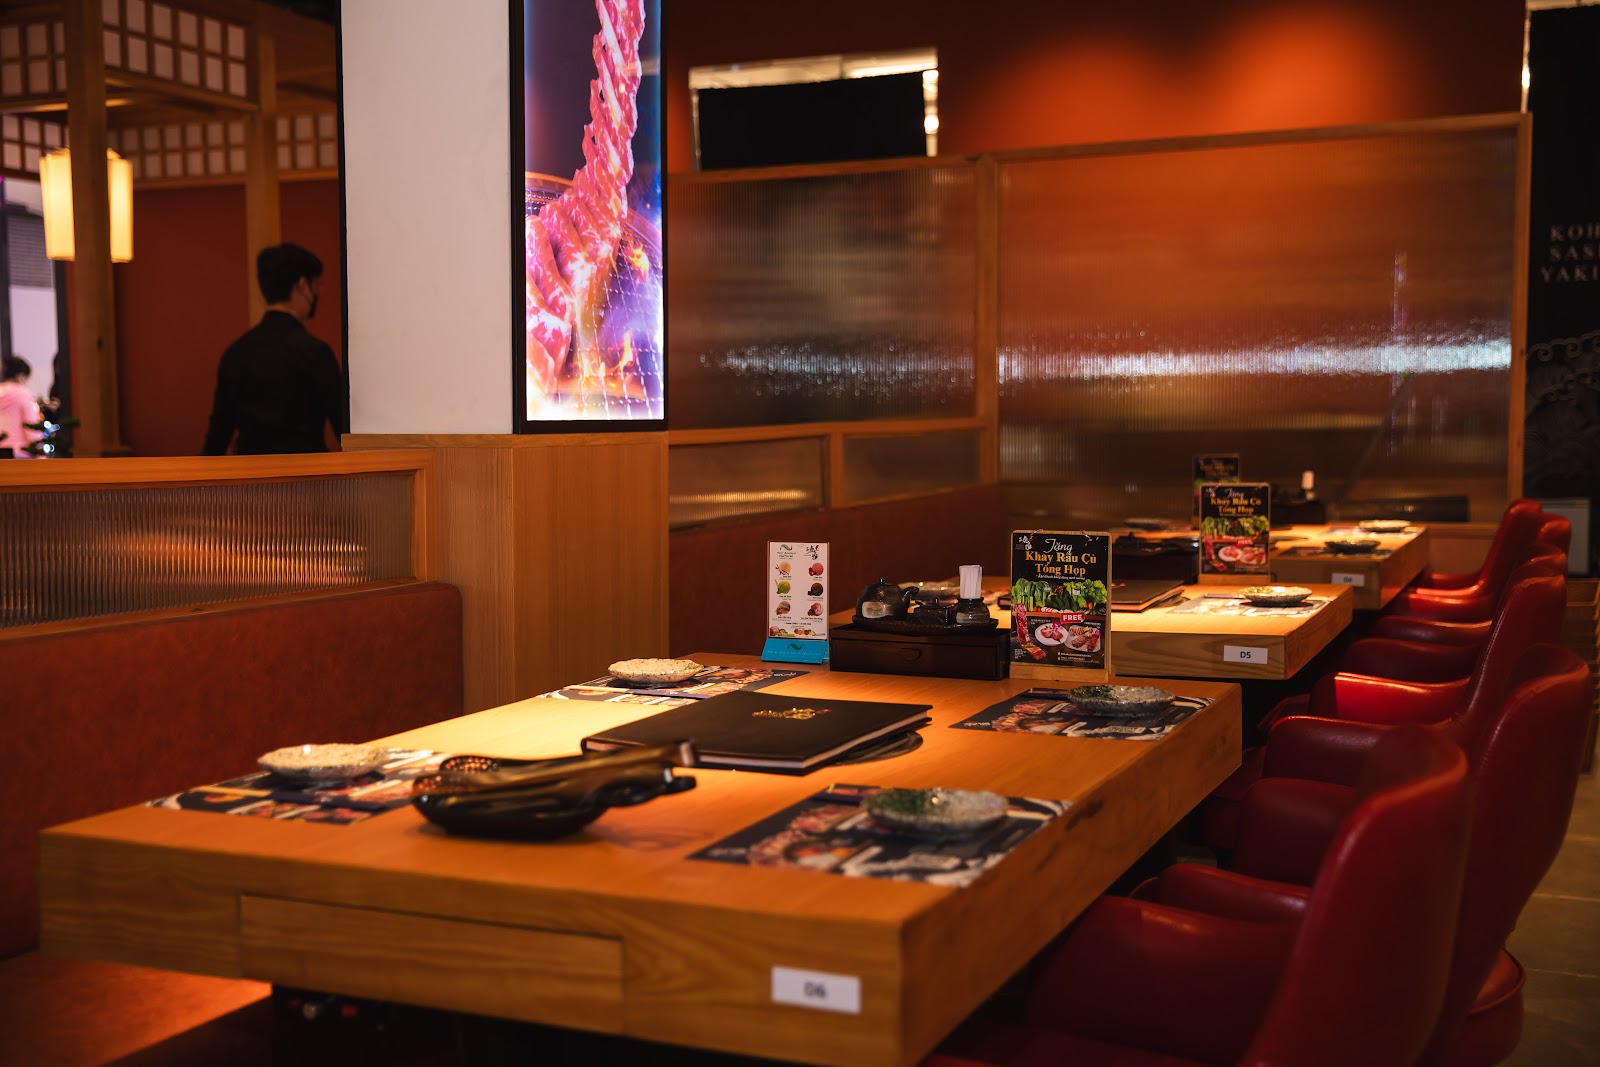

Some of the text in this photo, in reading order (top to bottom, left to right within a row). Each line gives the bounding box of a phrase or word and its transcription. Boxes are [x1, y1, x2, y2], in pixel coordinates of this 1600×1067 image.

[1550, 243, 1600, 261] SAS
[1541, 264, 1598, 283] YAKI
[1025, 551, 1053, 564] Khay
[1240, 651, 1251, 659] D5
